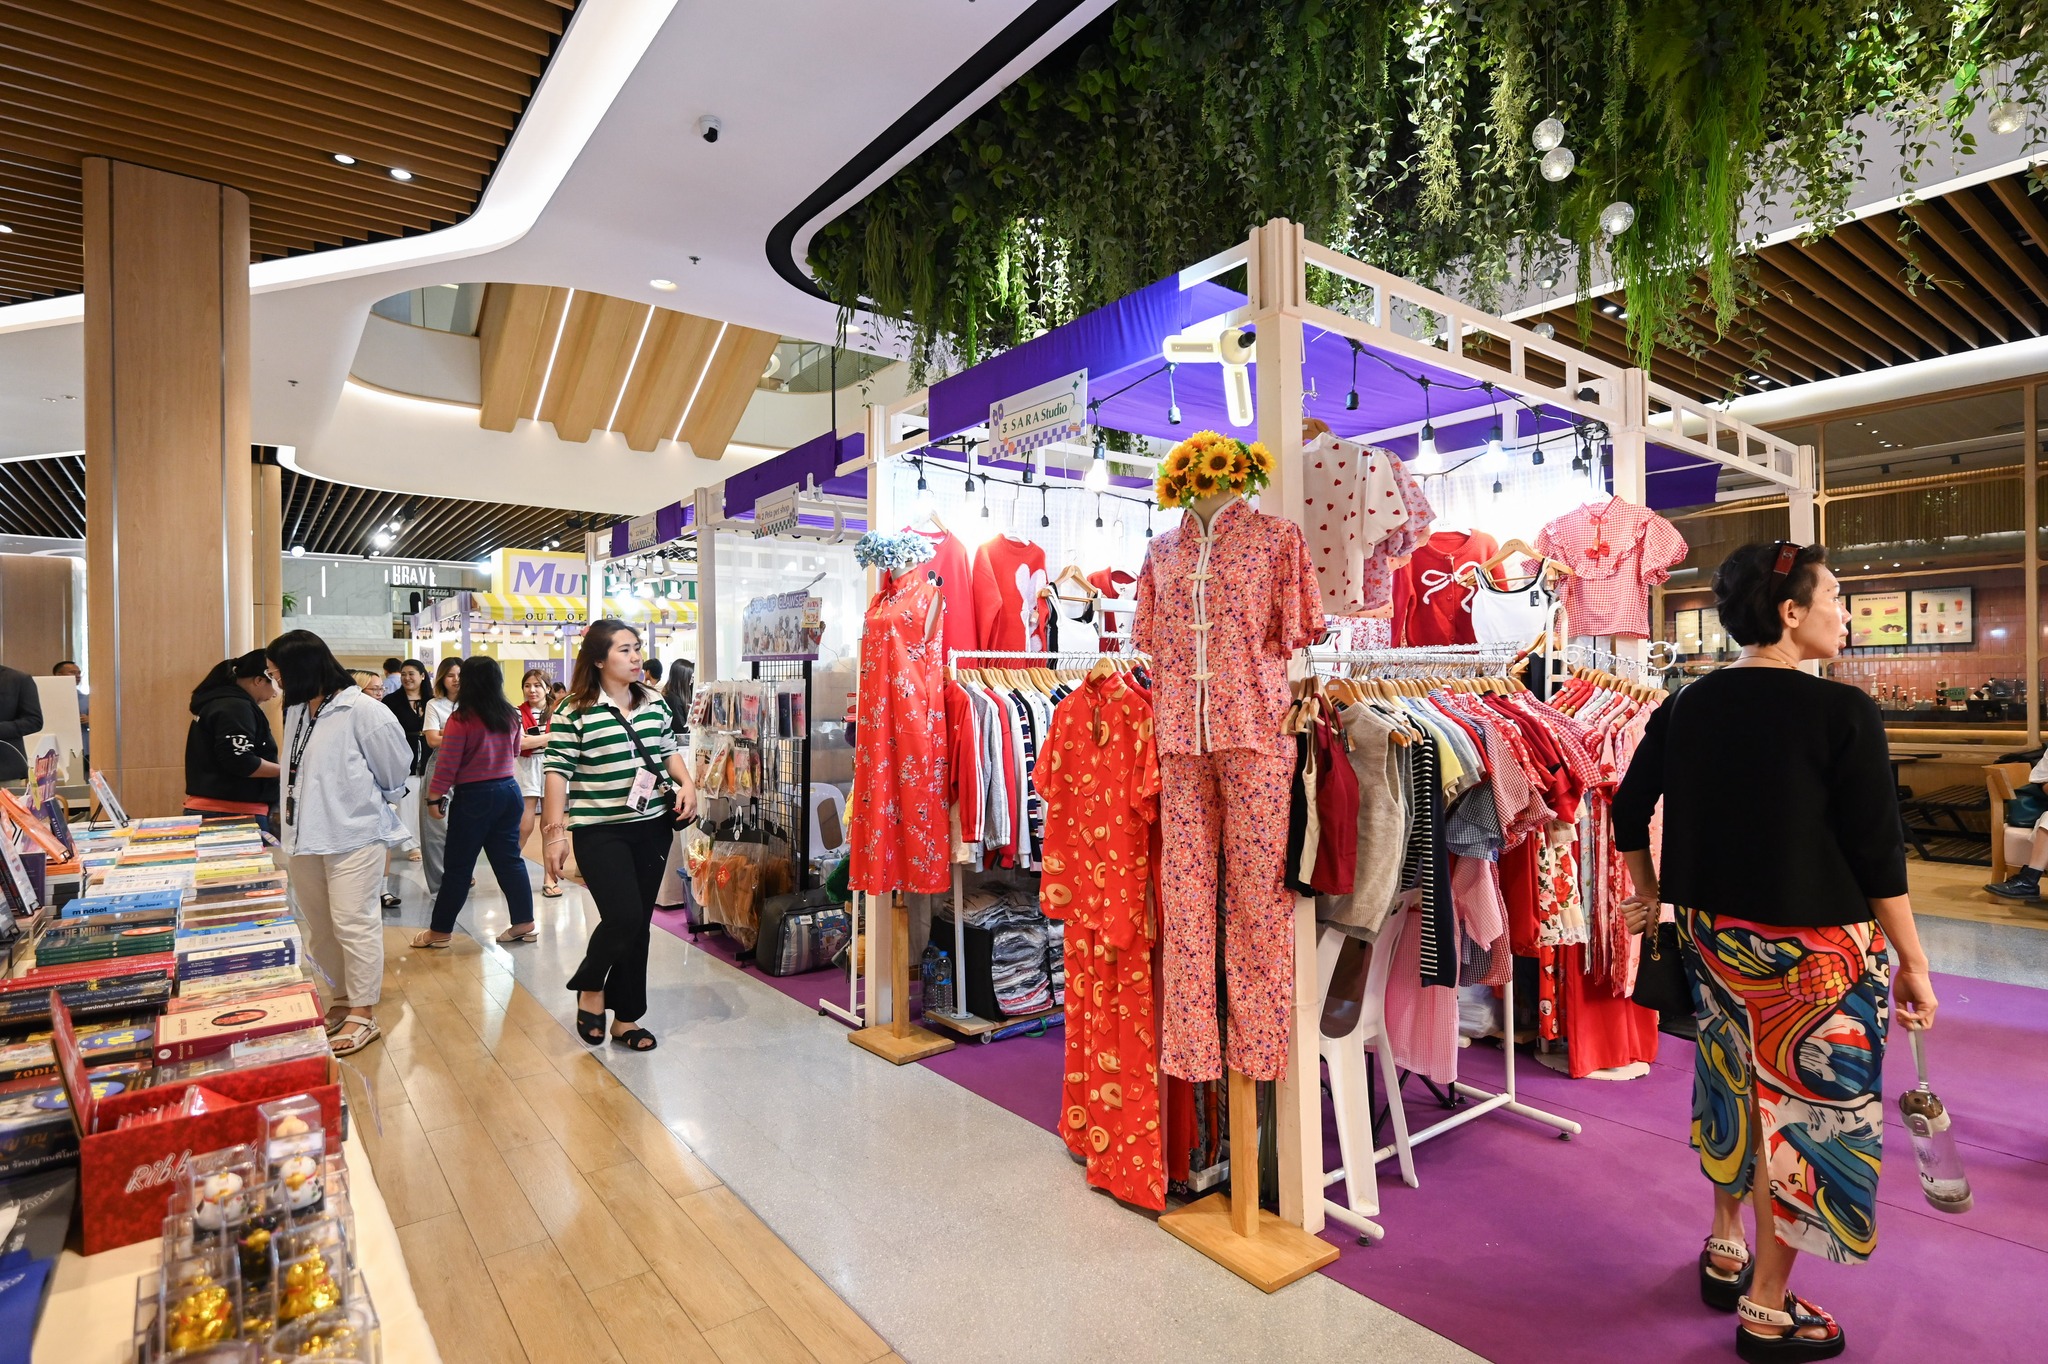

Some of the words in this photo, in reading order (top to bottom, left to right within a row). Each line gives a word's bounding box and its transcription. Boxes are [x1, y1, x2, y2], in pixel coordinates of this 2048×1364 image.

[1002, 422, 1008, 433] 3
[1041, 402, 1068, 421] Studio
[780, 505, 790, 516] shop
[567, 613, 584, 621] OF
[528, 661, 557, 669] SHARE
[72, 906, 108, 916] mindset
[59, 927, 78, 938] THE
[79, 925, 106, 937] MIND
[14, 1065, 59, 1080] ZODIA
[1708, 1241, 1744, 1259] CHANEL
